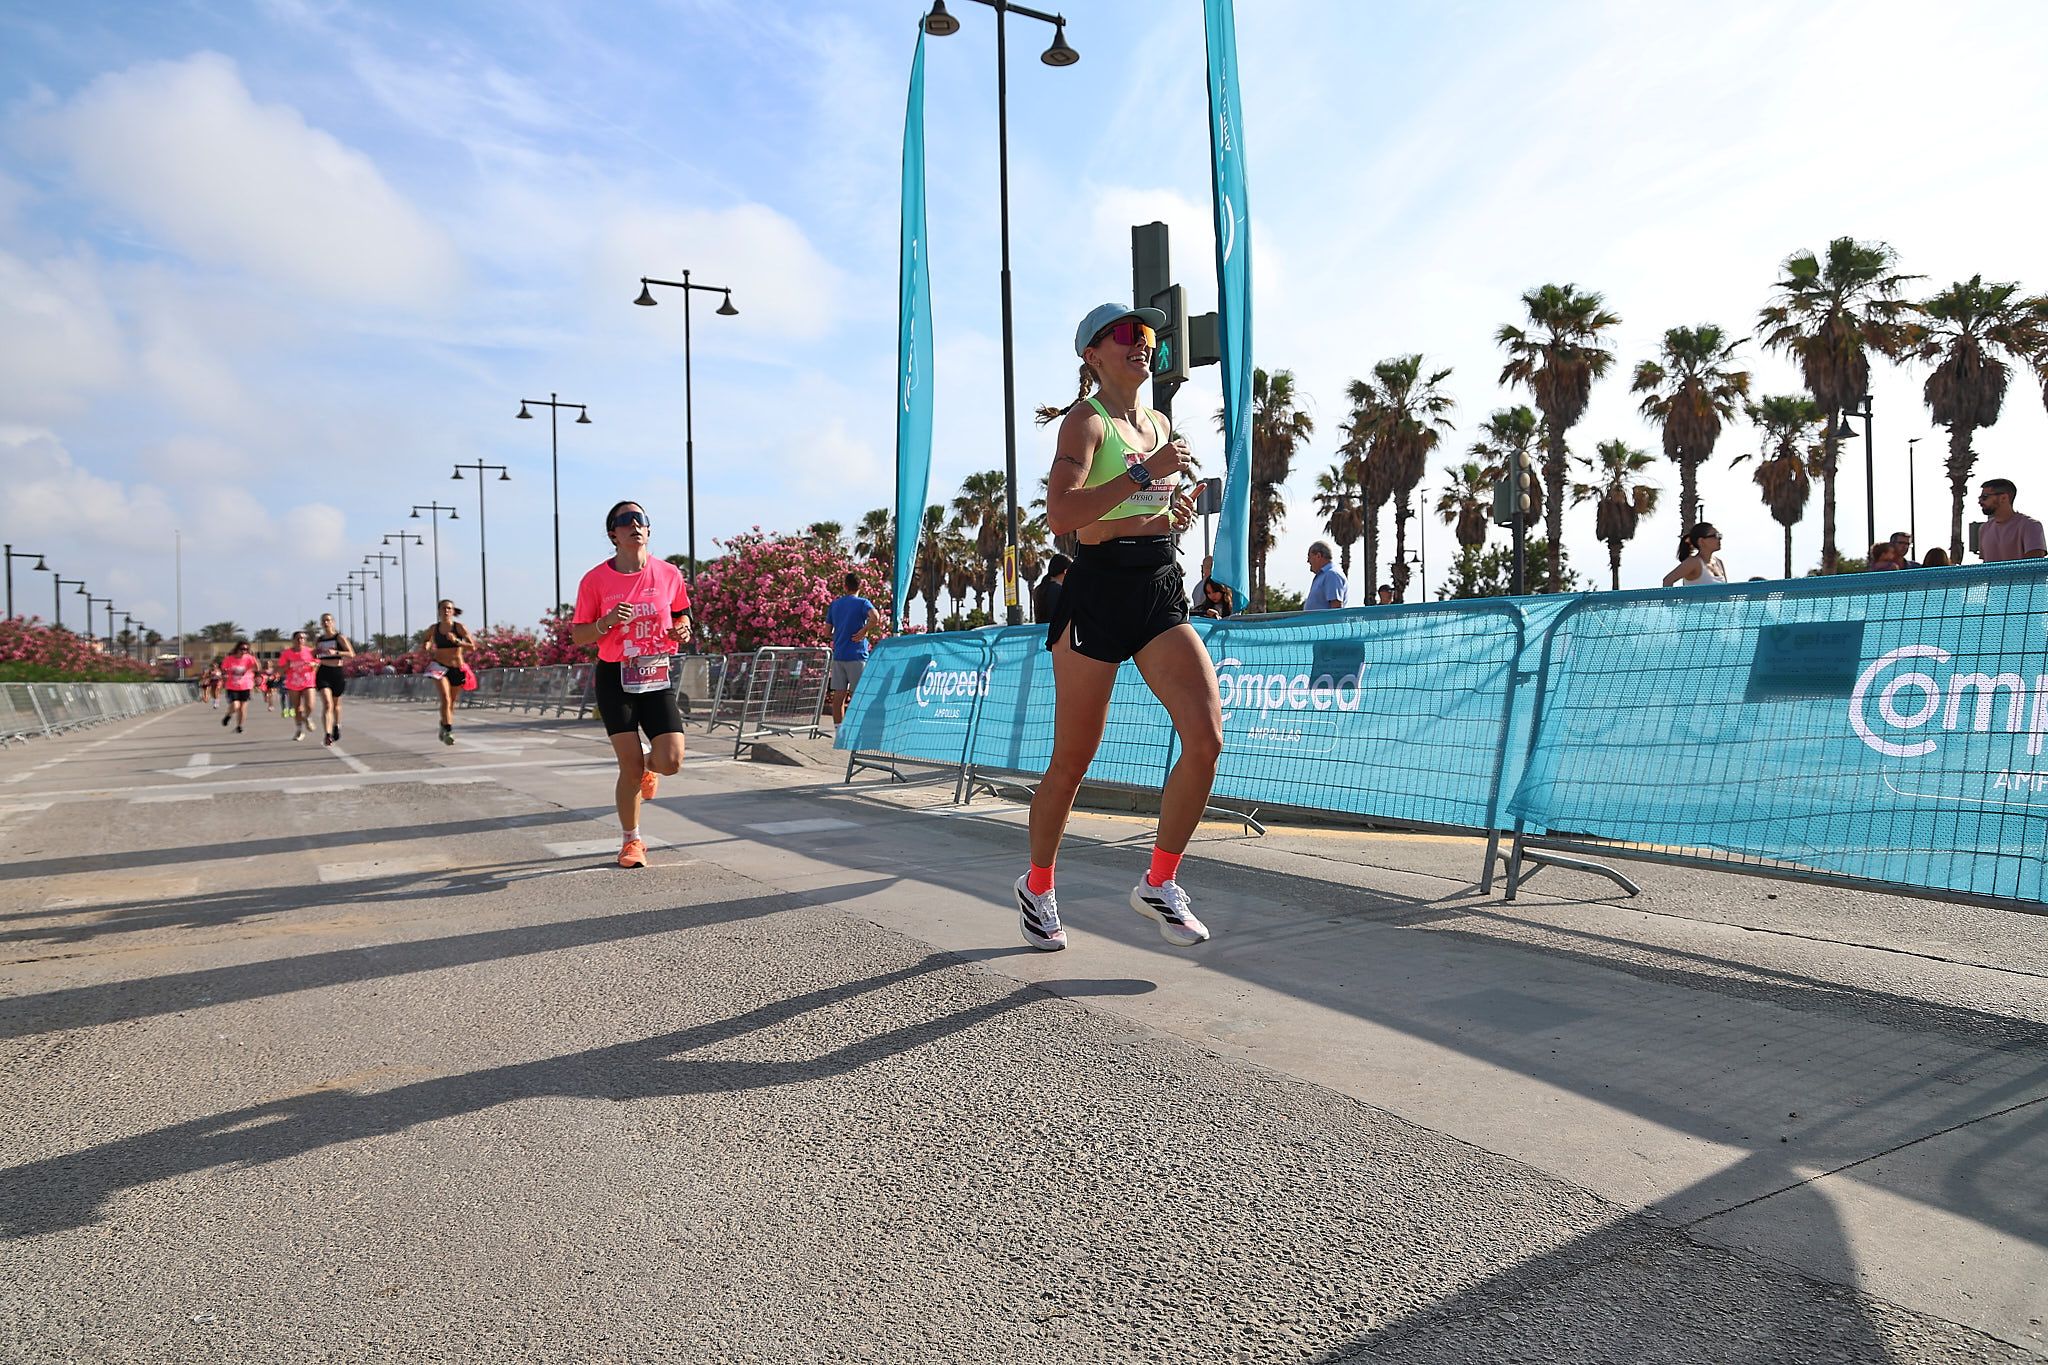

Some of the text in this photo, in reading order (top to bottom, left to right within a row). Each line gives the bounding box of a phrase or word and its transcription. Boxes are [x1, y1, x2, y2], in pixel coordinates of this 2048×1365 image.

[639, 666, 657, 676] 016
[916, 660, 994, 707] Compeed
[934, 708, 960, 718] AMPOLLAS
[1248, 726, 1301, 742] AMPOLLAS
